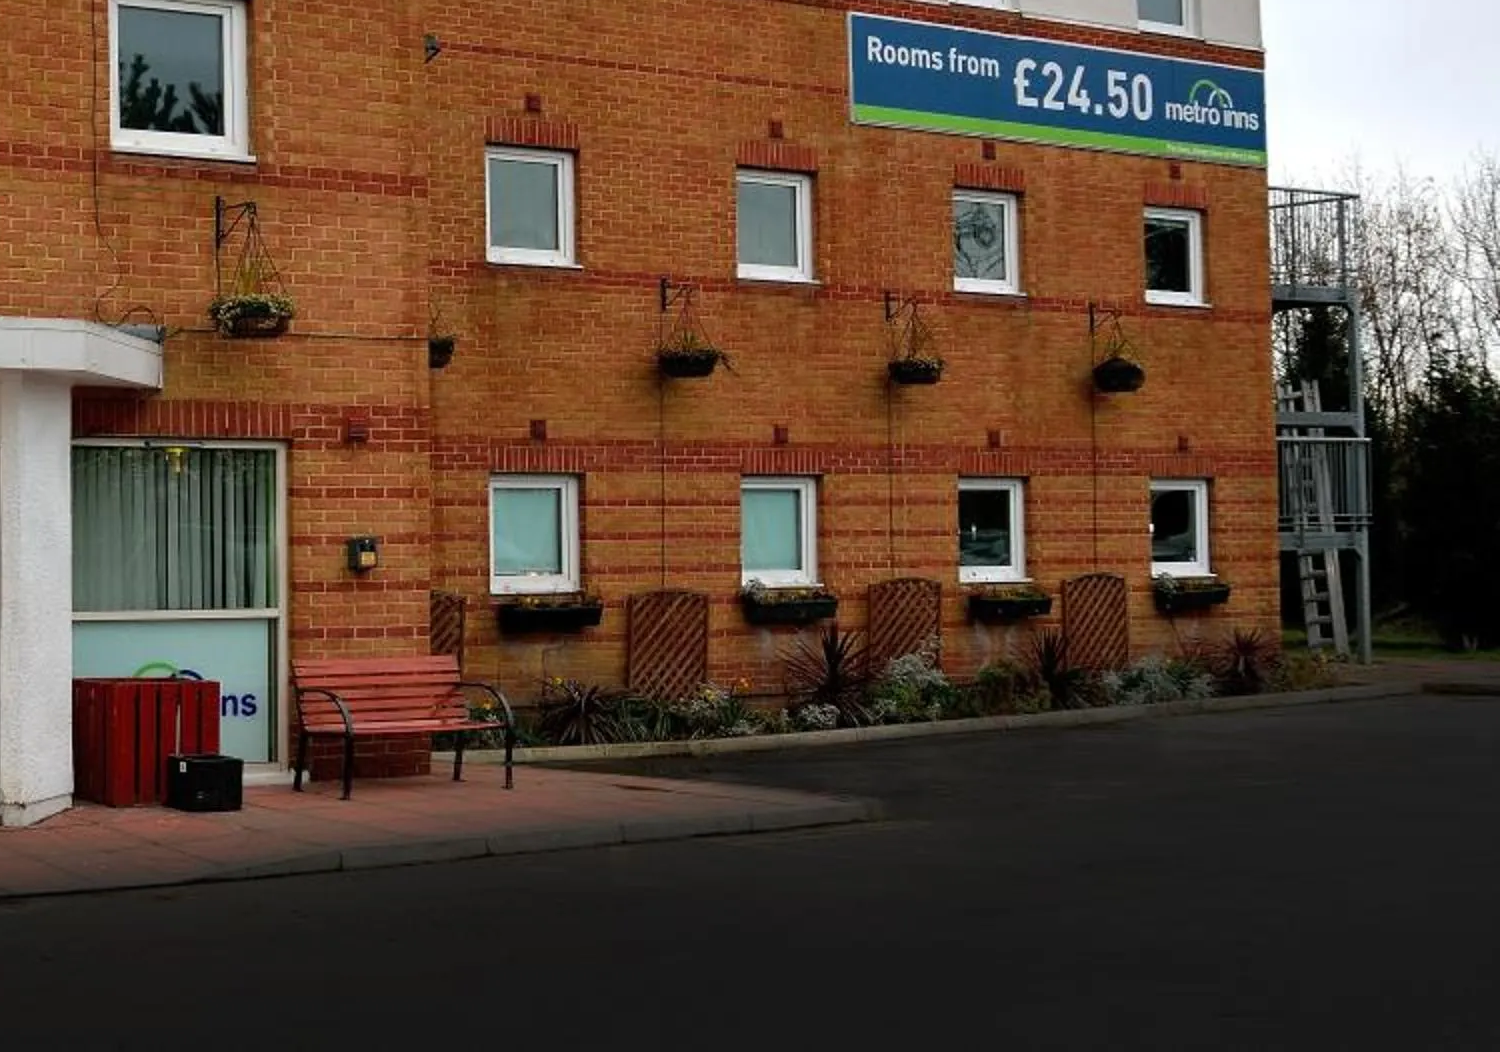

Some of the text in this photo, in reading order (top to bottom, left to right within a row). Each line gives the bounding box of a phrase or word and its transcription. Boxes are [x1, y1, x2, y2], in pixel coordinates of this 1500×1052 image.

[867, 35, 1000, 79] Rooms from
[1013, 57, 1153, 122] £24.50
[1165, 100, 1260, 131] metro inns
[221, 693, 257, 717] ns
